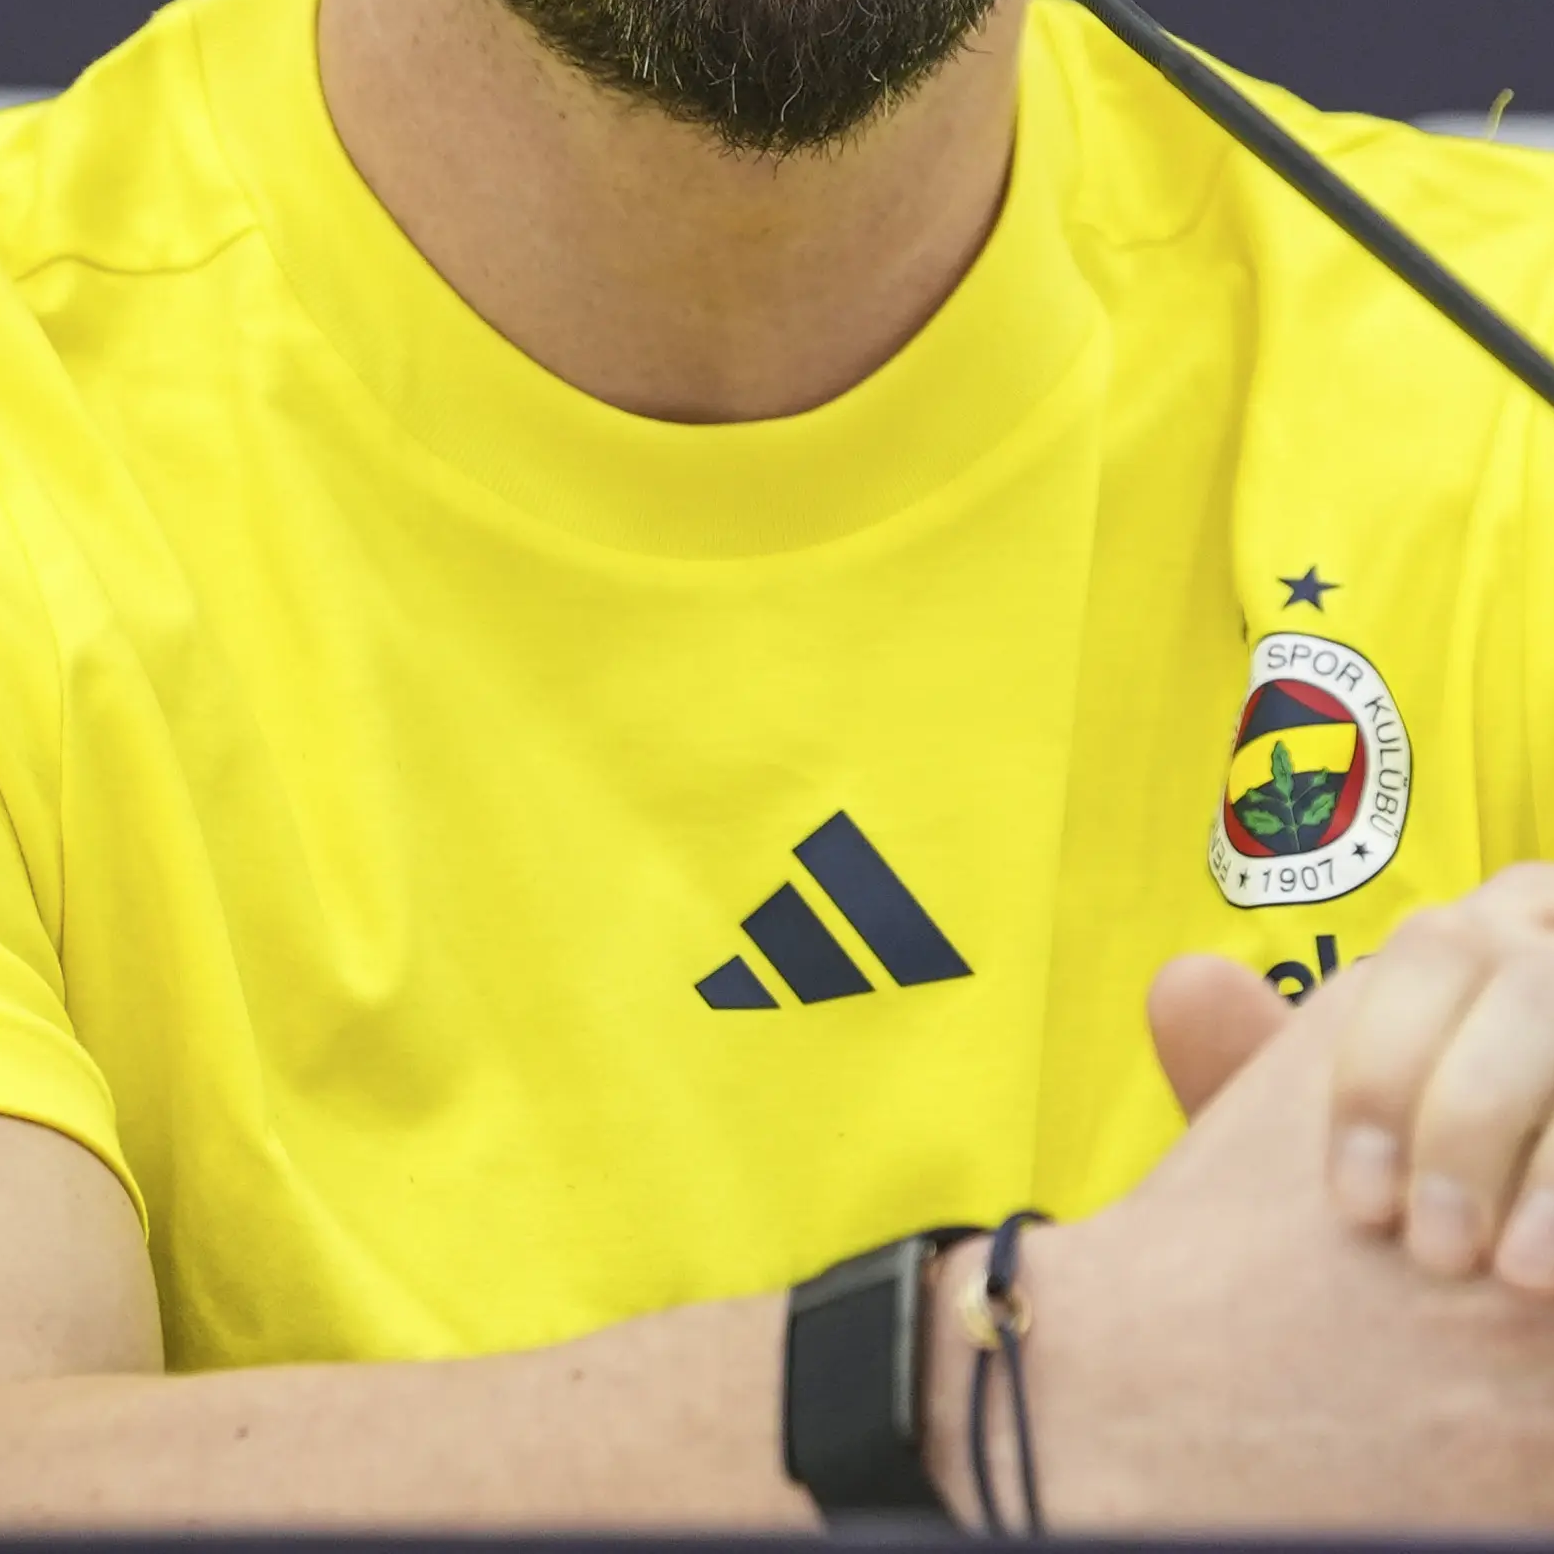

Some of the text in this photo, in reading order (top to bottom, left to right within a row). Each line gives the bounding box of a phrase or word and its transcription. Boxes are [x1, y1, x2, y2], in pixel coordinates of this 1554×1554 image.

[1266, 643, 1408, 838] SPOR KULÜBÜ
[1260, 858, 1337, 893] 1907
